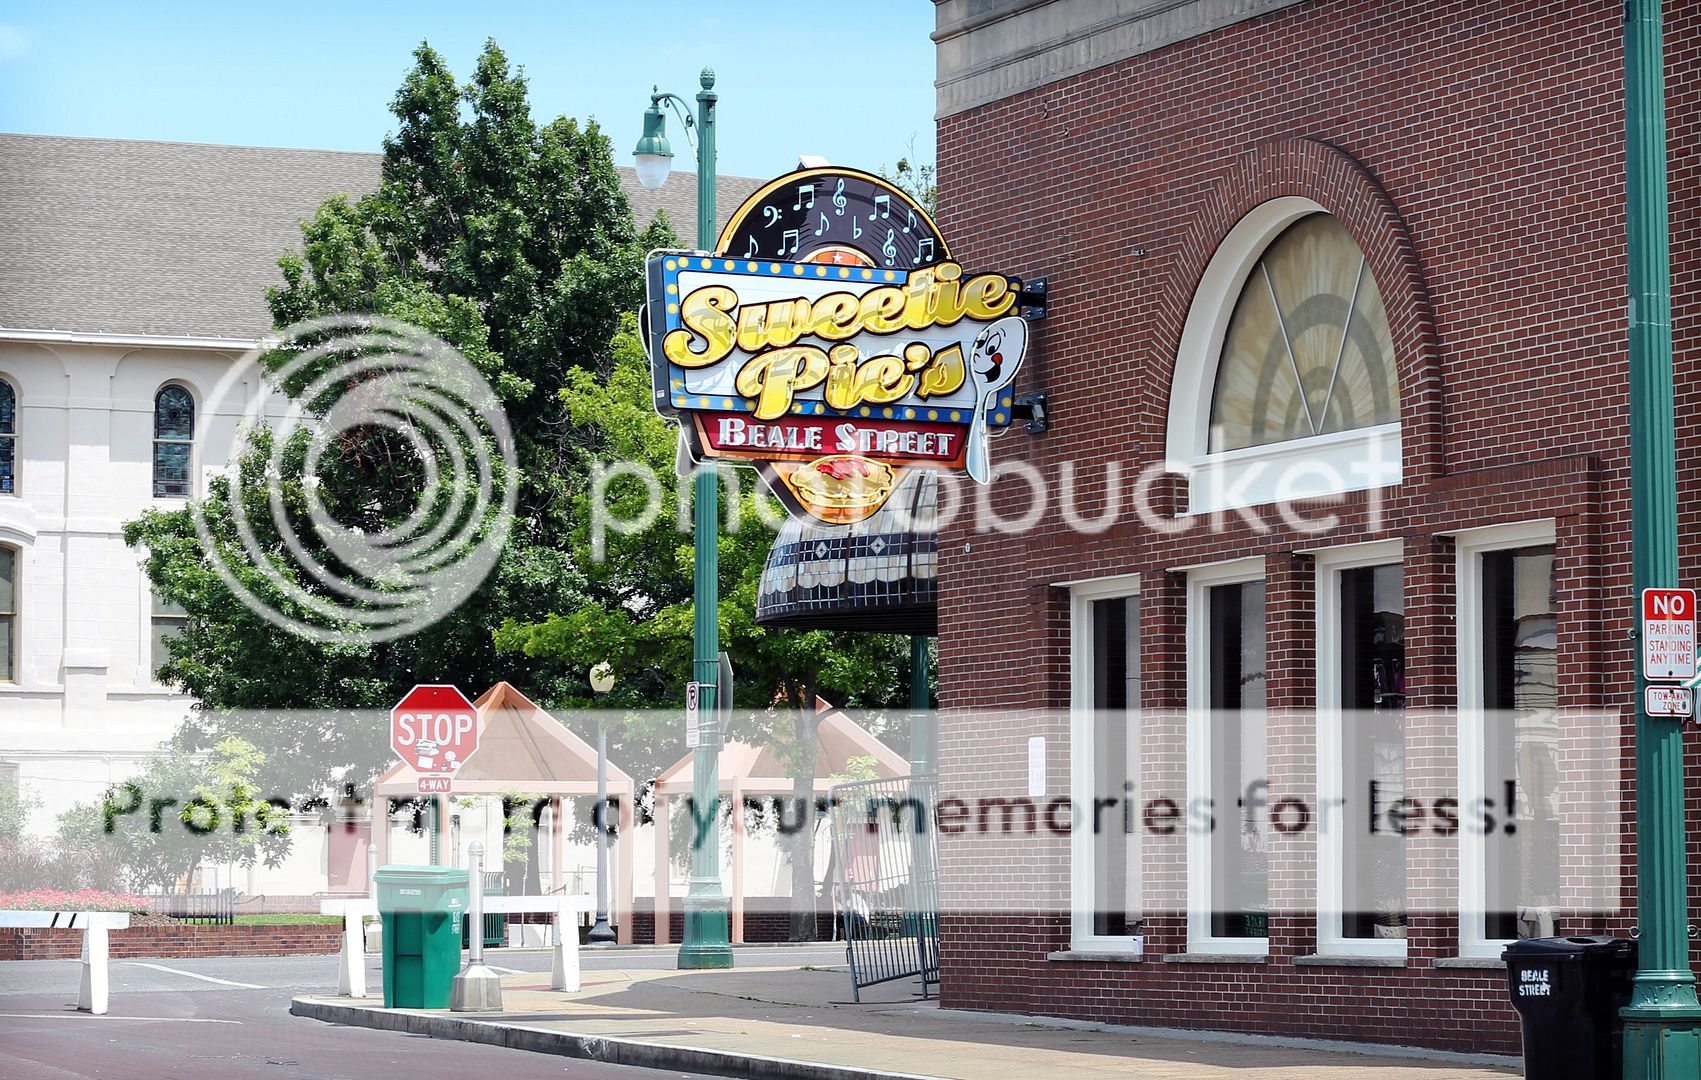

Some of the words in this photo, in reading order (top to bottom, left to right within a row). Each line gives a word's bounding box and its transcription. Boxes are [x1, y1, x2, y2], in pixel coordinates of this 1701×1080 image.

[663, 262, 1016, 368] Sweetie
[735, 342, 966, 421] Pie's
[716, 418, 823, 450] BEALE
[834, 423, 956, 457] STREET
[1653, 595, 1685, 615] NO
[1649, 623, 1691, 635] PARKING
[1649, 640, 1692, 652] STANDING
[1650, 653, 1691, 665] ANYTIME
[1662, 701, 1681, 711] ZONE
[397, 713, 473, 746] STOP
[419, 779, 449, 790] 4-WAY
[1521, 969, 1549, 982] BEALE
[1519, 982, 1551, 996] STREET
